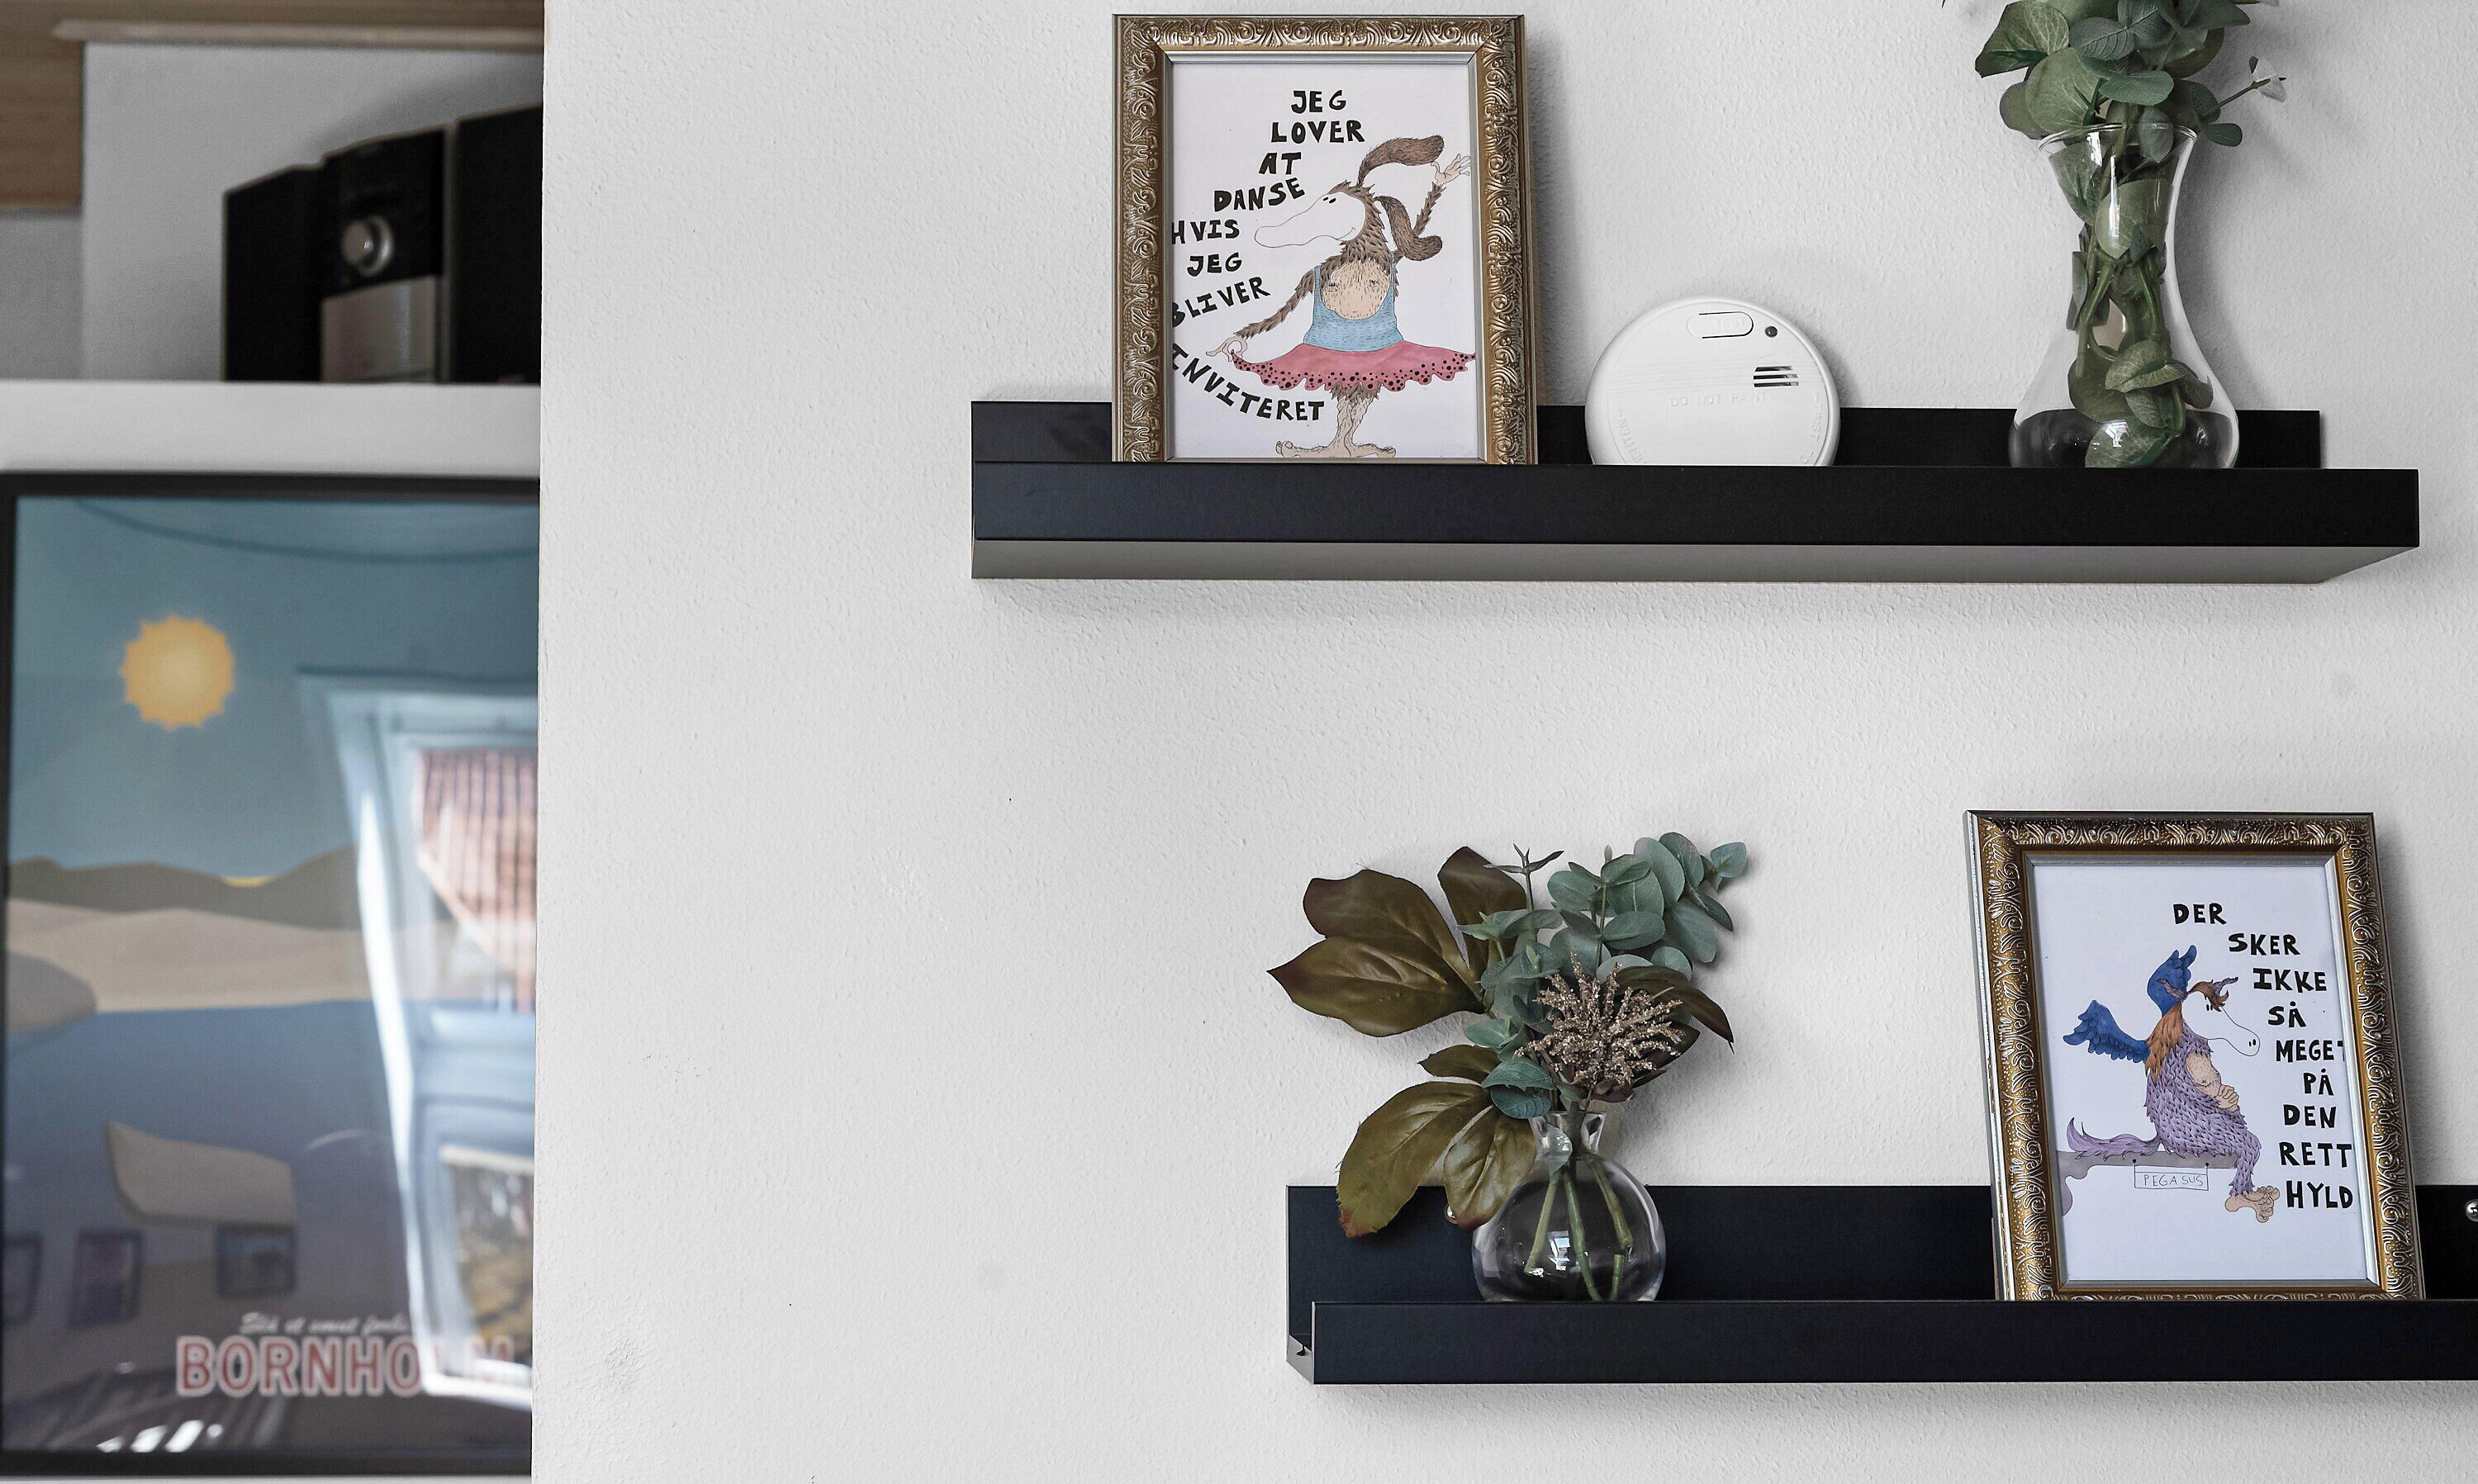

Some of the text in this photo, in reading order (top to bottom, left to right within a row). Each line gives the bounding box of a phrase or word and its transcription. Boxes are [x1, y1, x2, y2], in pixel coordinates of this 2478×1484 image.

[1291, 90, 1346, 113] JEG
[1270, 119, 1365, 144] LOVER
[1258, 152, 1302, 174] AT
[1213, 178, 1305, 212] DANSE
[1172, 220, 1240, 244] HVIS
[1187, 253, 1242, 277] JEG
[1172, 276, 1271, 328] BLIVER
[1172, 343, 1325, 421] INVITERET
[1697, 394, 1722, 405] NOT
[2172, 903, 2228, 925] DER
[2229, 932, 2301, 956] SKER
[2253, 968, 2328, 993] IKKE
[2267, 1001, 2307, 1028] SÅ
[2304, 1068, 2334, 1097] PÅ
[2284, 1104, 2337, 1129] DEN
[2279, 1141, 2352, 1168] RETT
[2143, 1173, 2204, 1187] PEGASUS
[2286, 1180, 2353, 1209] HYLD
